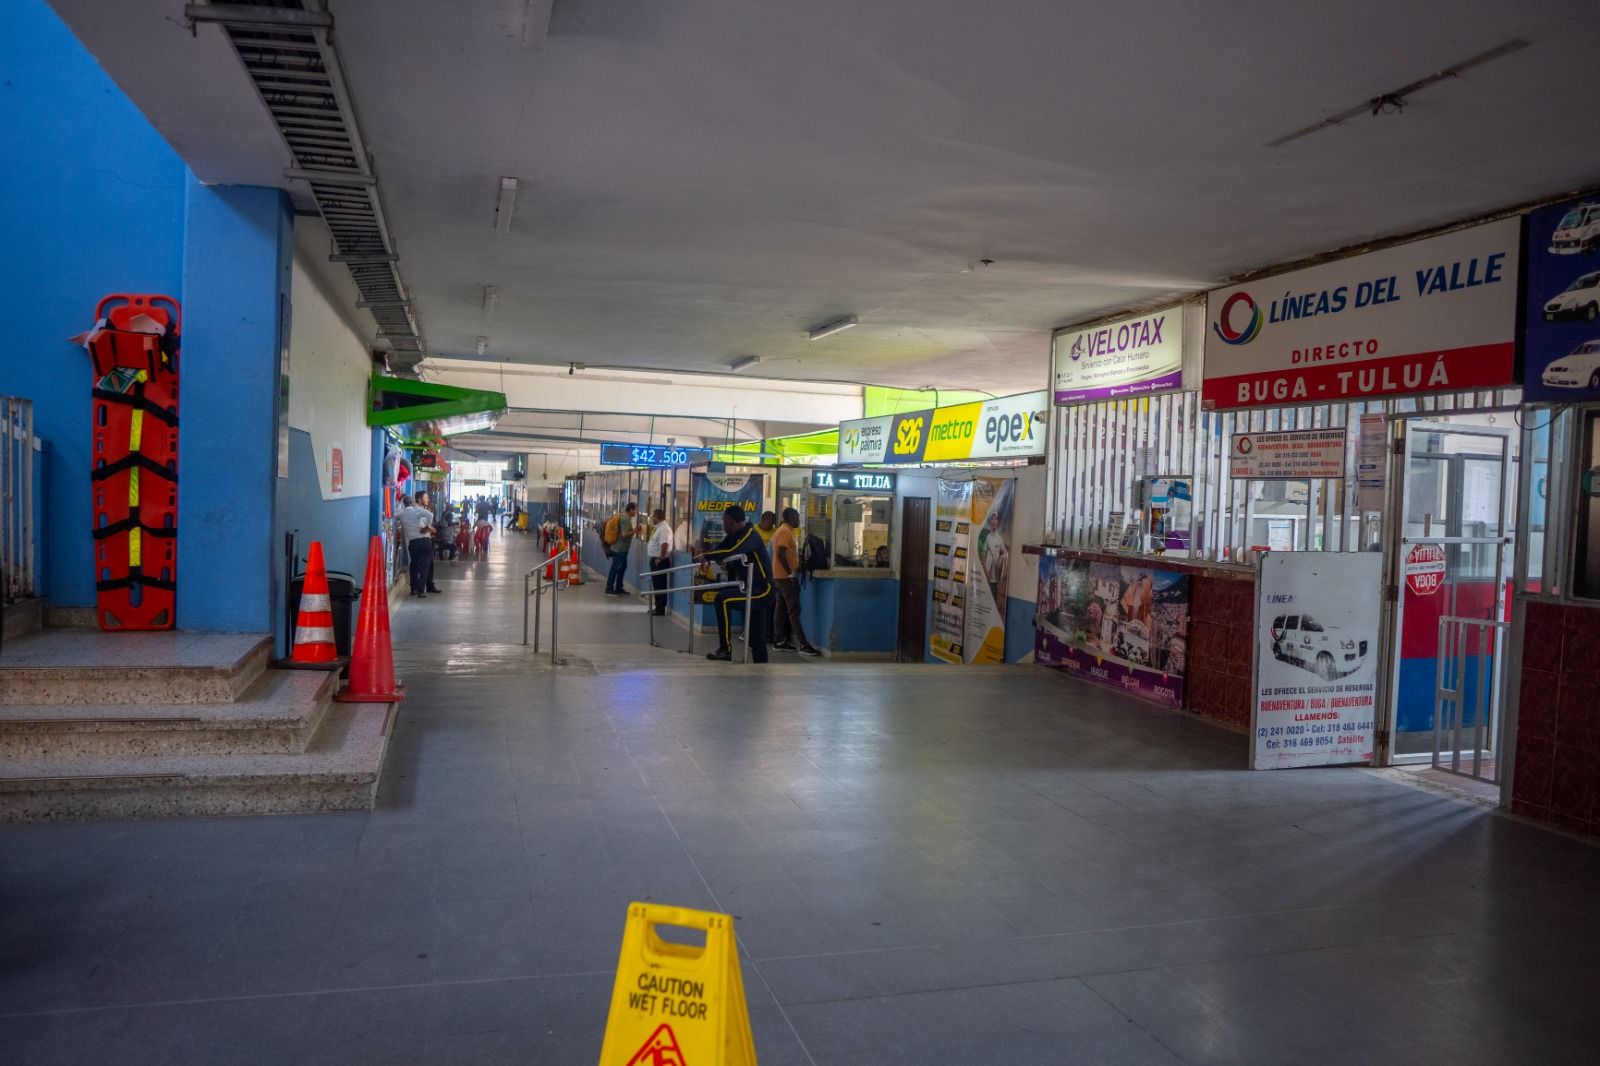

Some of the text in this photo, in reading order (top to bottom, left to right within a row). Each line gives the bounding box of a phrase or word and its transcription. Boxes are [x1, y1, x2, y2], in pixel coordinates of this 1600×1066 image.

[1269, 252, 1506, 324] LÍNEAS DEL VALLE
[1088, 316, 1166, 358] VELOTAX
[1291, 339, 1378, 364] DIRECTO
[1237, 377, 1307, 402] BUGA
[1337, 354, 1449, 394] TULUÁ
[861, 426, 882, 437] expreso
[931, 419, 973, 442] mettro
[985, 411, 1036, 452] epex
[860, 438, 882, 454] palmira
[697, 499, 757, 512] MEDEÍN
[1261, 684, 1374, 696] LES OFRECE EL SERVICIO DE RESERVAS
[1260, 699, 1305, 711] BUENAVENTURA
[1310, 698, 1326, 710] BUGA
[1330, 696, 1373, 708] BUENAVENTURA
[1258, 727, 1268, 738] (2)
[1270, 727, 1283, 736] 241
[1286, 726, 1304, 735] 0020
[1311, 724, 1326, 734] Cel:
[1266, 739, 1281, 749] Cel:
[1283, 739, 1297, 748] 316
[1300, 738, 1313, 747] 469
[1315, 736, 1333, 746] 9054
[637, 973, 704, 999] CAUTION
[629, 992, 707, 1020] WET FLOOR
